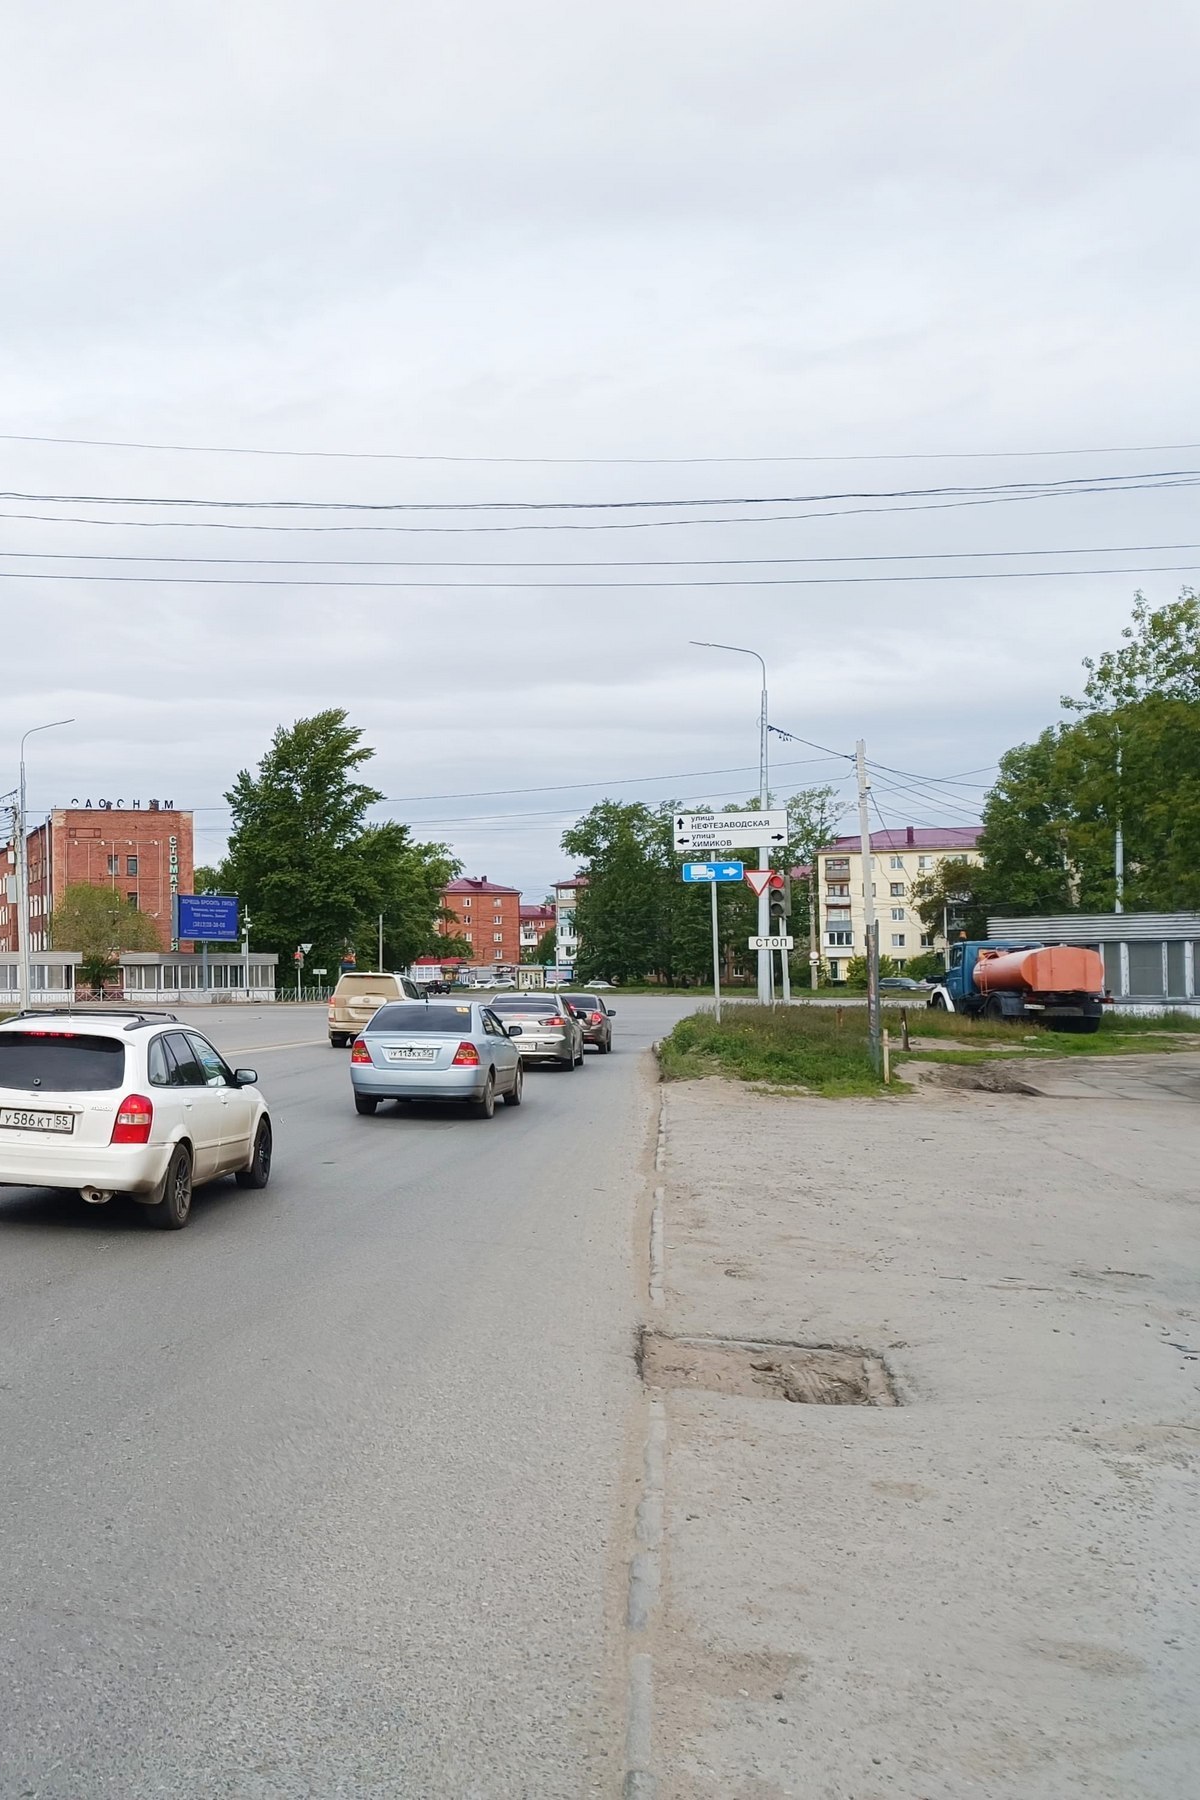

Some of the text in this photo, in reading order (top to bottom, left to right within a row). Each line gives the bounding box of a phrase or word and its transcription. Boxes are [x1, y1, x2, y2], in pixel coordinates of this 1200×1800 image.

[691, 820, 770, 830] НЕФТЕЗАВОДСКАЯ
[692, 839, 733, 848] ХИМИКОВ
[756, 938, 787, 947] СТОП
[5, 1112, 68, 1127] У586КТ 55
